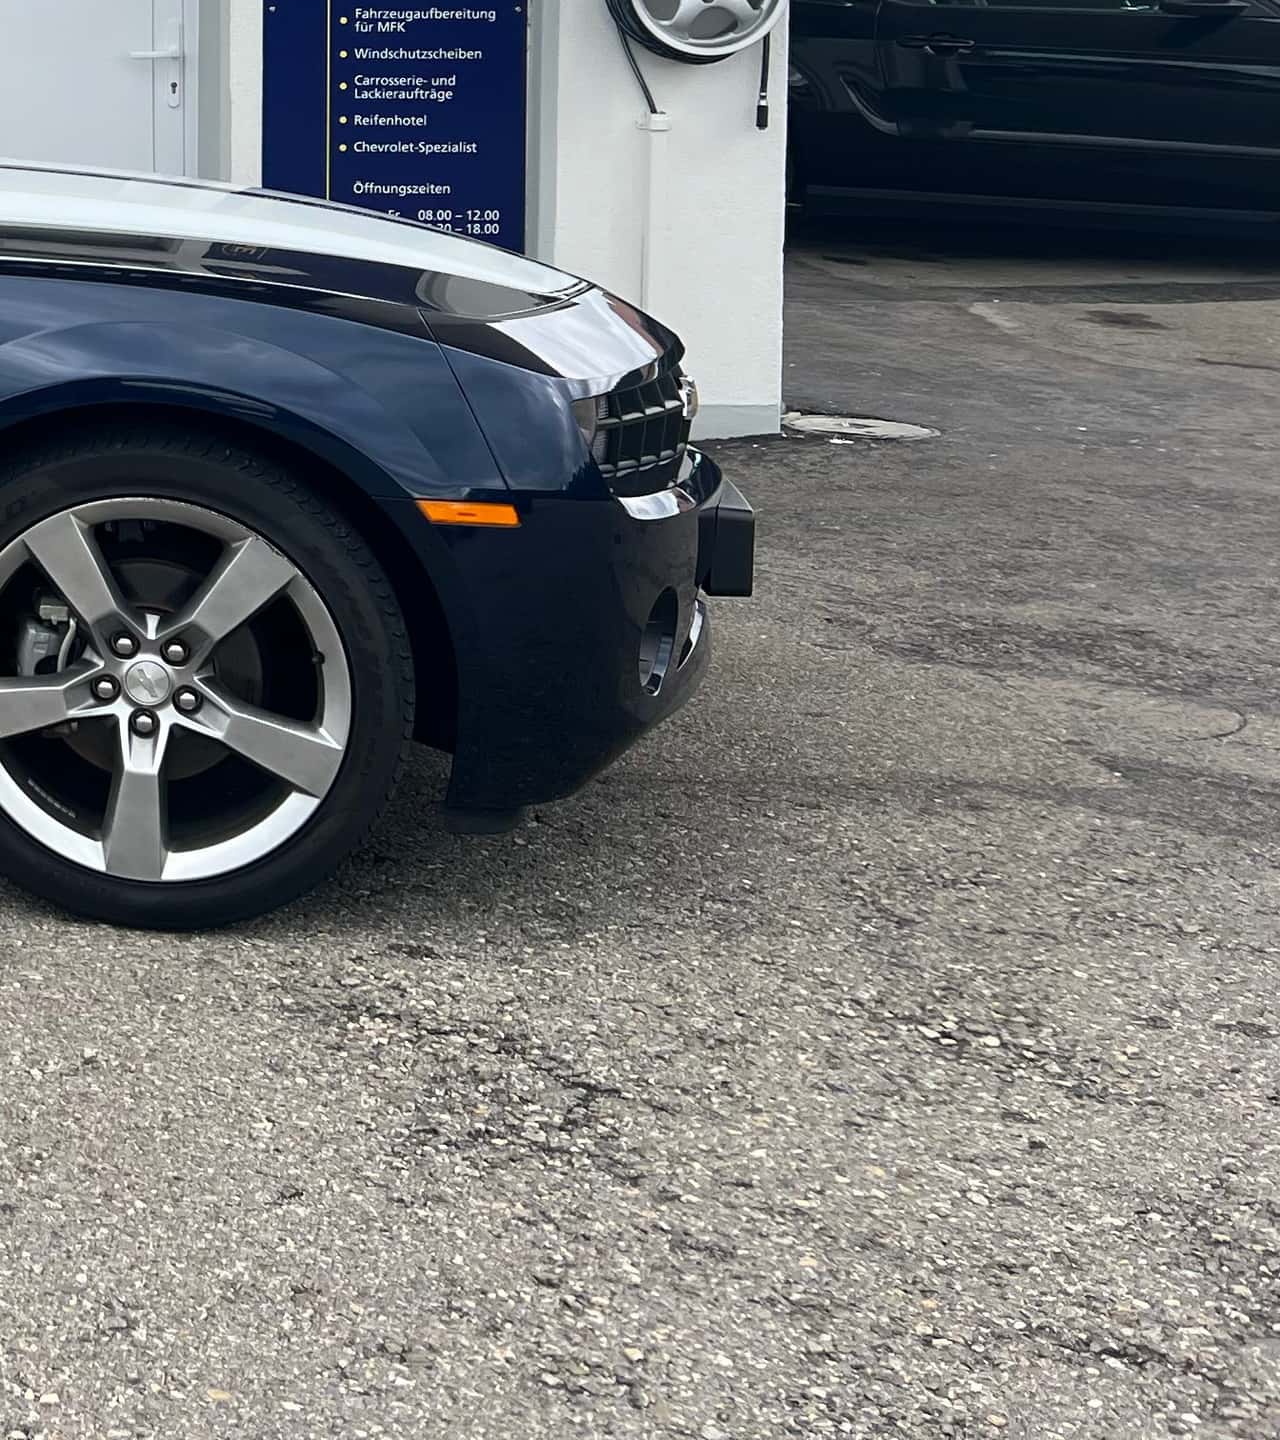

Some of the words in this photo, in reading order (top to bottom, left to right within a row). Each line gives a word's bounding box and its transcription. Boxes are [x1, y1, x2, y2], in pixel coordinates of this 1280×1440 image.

[355, 7, 496, 22] Fahrzeugaufbereitung
[354, 21, 374, 33] für
[377, 22, 406, 33] MFK
[354, 47, 482, 60] Windschutzscheiben
[354, 74, 428, 87] Carrosserie-
[431, 74, 457, 86] und
[354, 87, 454, 102] Lackieraufträge
[354, 114, 428, 127] Reifenhotel
[353, 140, 478, 155] Chevrolet-Spezialist
[353, 180, 451, 197] Öffnungszeiten
[417, 209, 452, 221] 08.00
[466, 209, 500, 221] 12.00
[466, 223, 500, 235] 18.00
